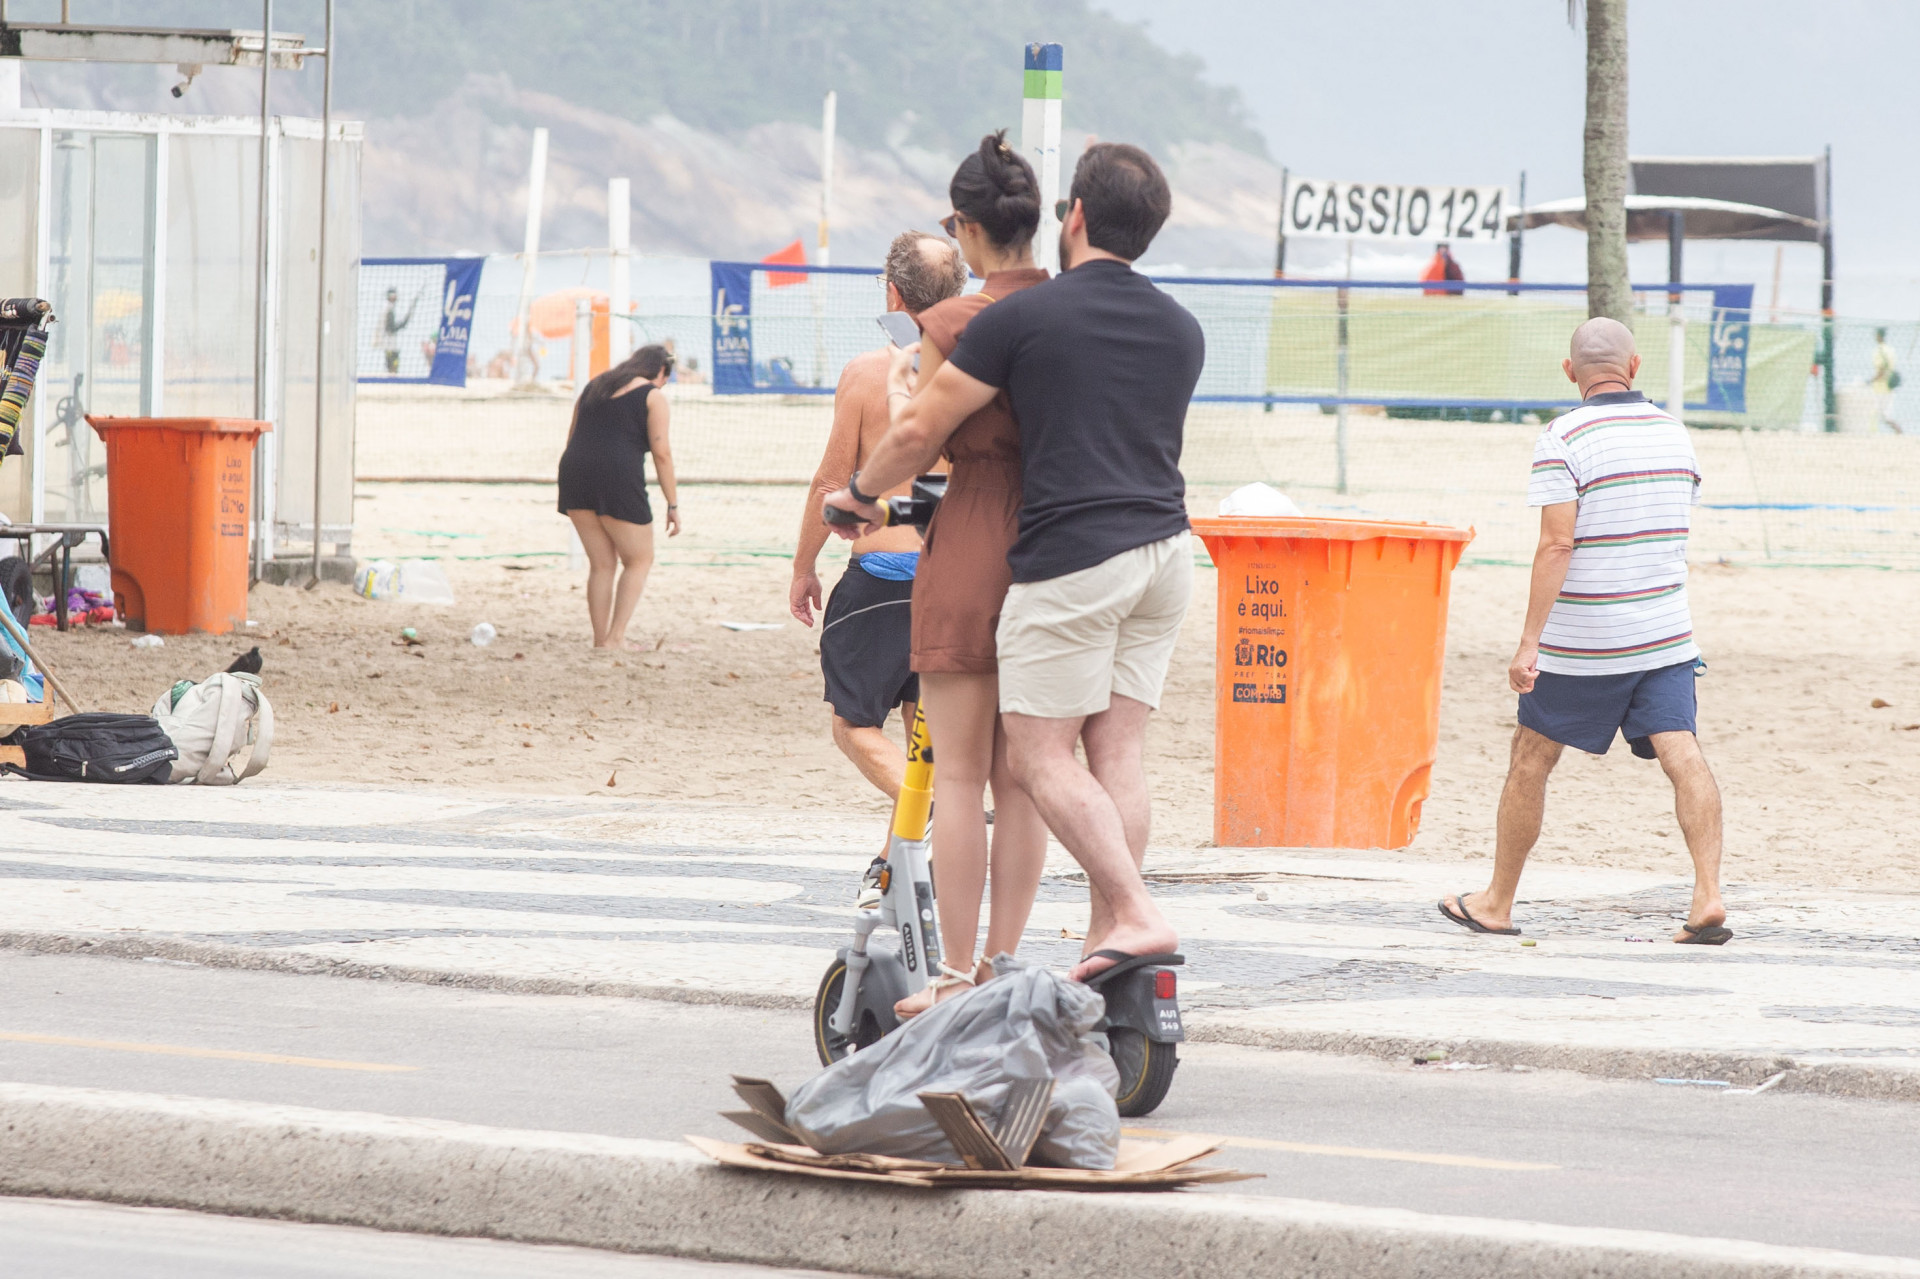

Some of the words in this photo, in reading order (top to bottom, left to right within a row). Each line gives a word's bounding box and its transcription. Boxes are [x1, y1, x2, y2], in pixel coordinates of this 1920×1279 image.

[1292, 183, 1431, 236] CASSIO
[1441, 188, 1502, 239] 124
[1246, 575, 1279, 595] Lixo
[1237, 598, 1246, 616] é
[1251, 599, 1287, 621] aqui.
[1257, 644, 1288, 667] Rio
[1234, 671, 1287, 679] PREFRA
